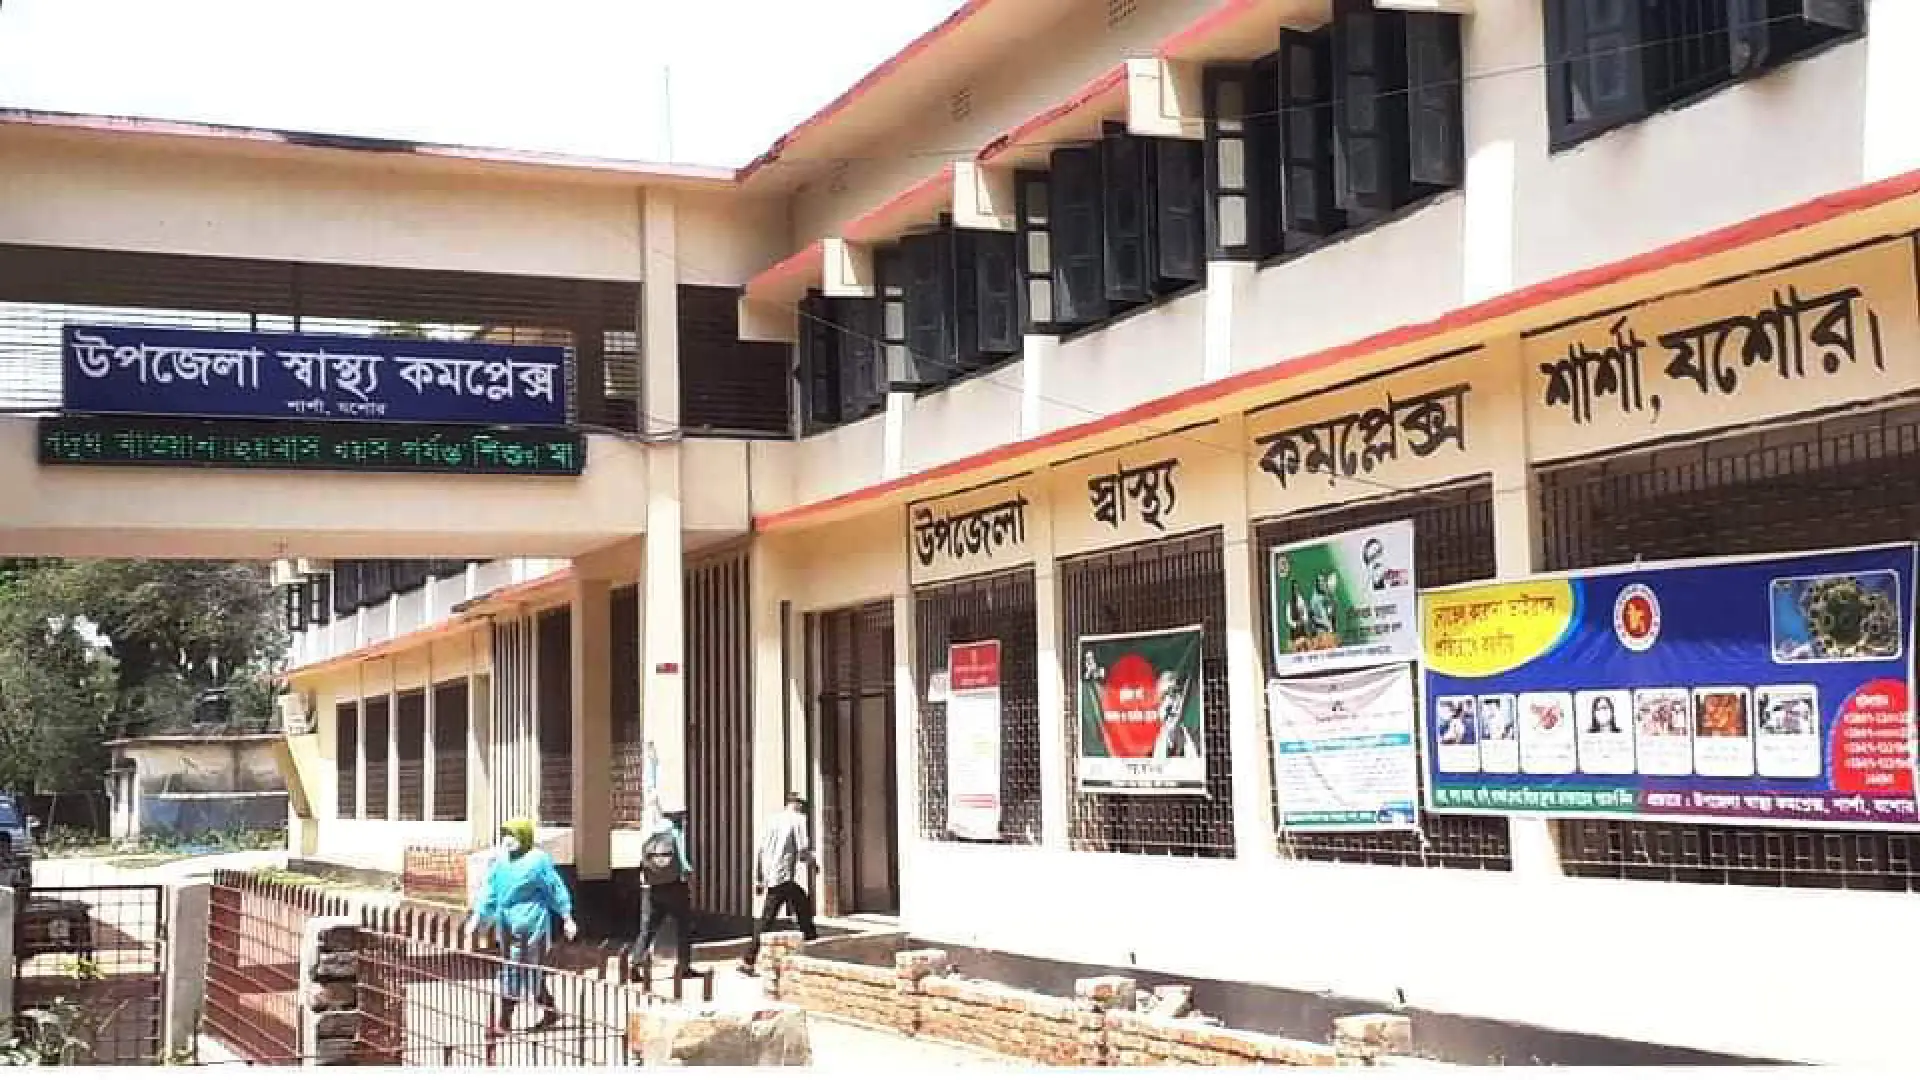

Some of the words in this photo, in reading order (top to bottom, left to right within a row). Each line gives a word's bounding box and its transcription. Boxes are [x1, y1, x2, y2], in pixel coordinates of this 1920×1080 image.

[71, 329, 265, 389] উপজেলা
[276, 347, 385, 402] স্বাস্থ্য
[393, 356, 559, 402] কমপ্লেক্স
[914, 489, 1029, 567] উপজেলা
[1087, 458, 1179, 531] স্বাস্থ্য
[1539, 315, 1663, 425] শার্শা,
